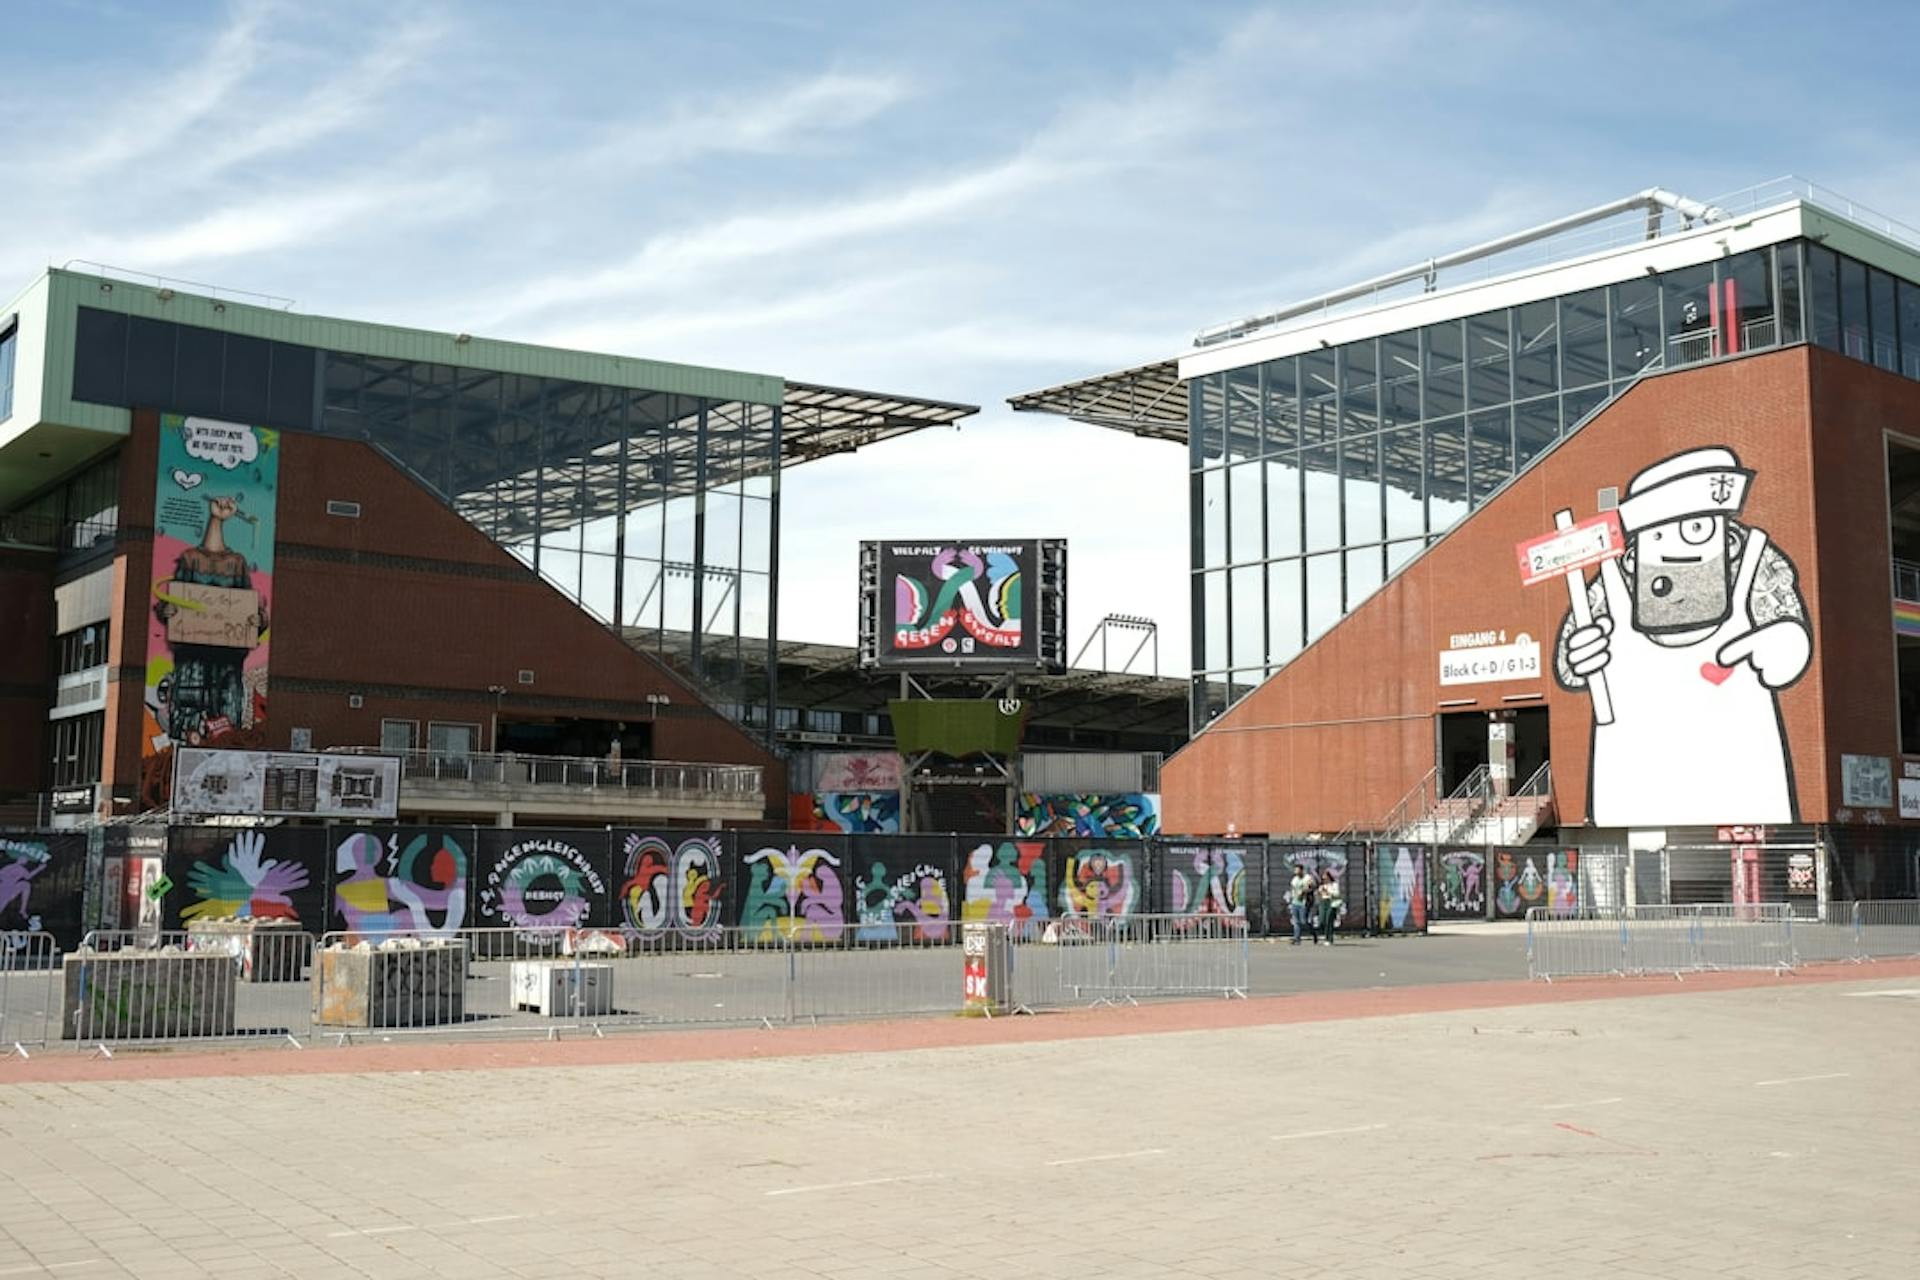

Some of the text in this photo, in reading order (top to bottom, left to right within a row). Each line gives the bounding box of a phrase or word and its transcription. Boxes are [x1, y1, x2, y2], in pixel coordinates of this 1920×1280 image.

[1534, 556, 1545, 571] 2
[1499, 630, 1507, 644] 4
[1444, 663, 1469, 678] Block
[1472, 662, 1479, 675] C
[1489, 661, 1498, 674] D
